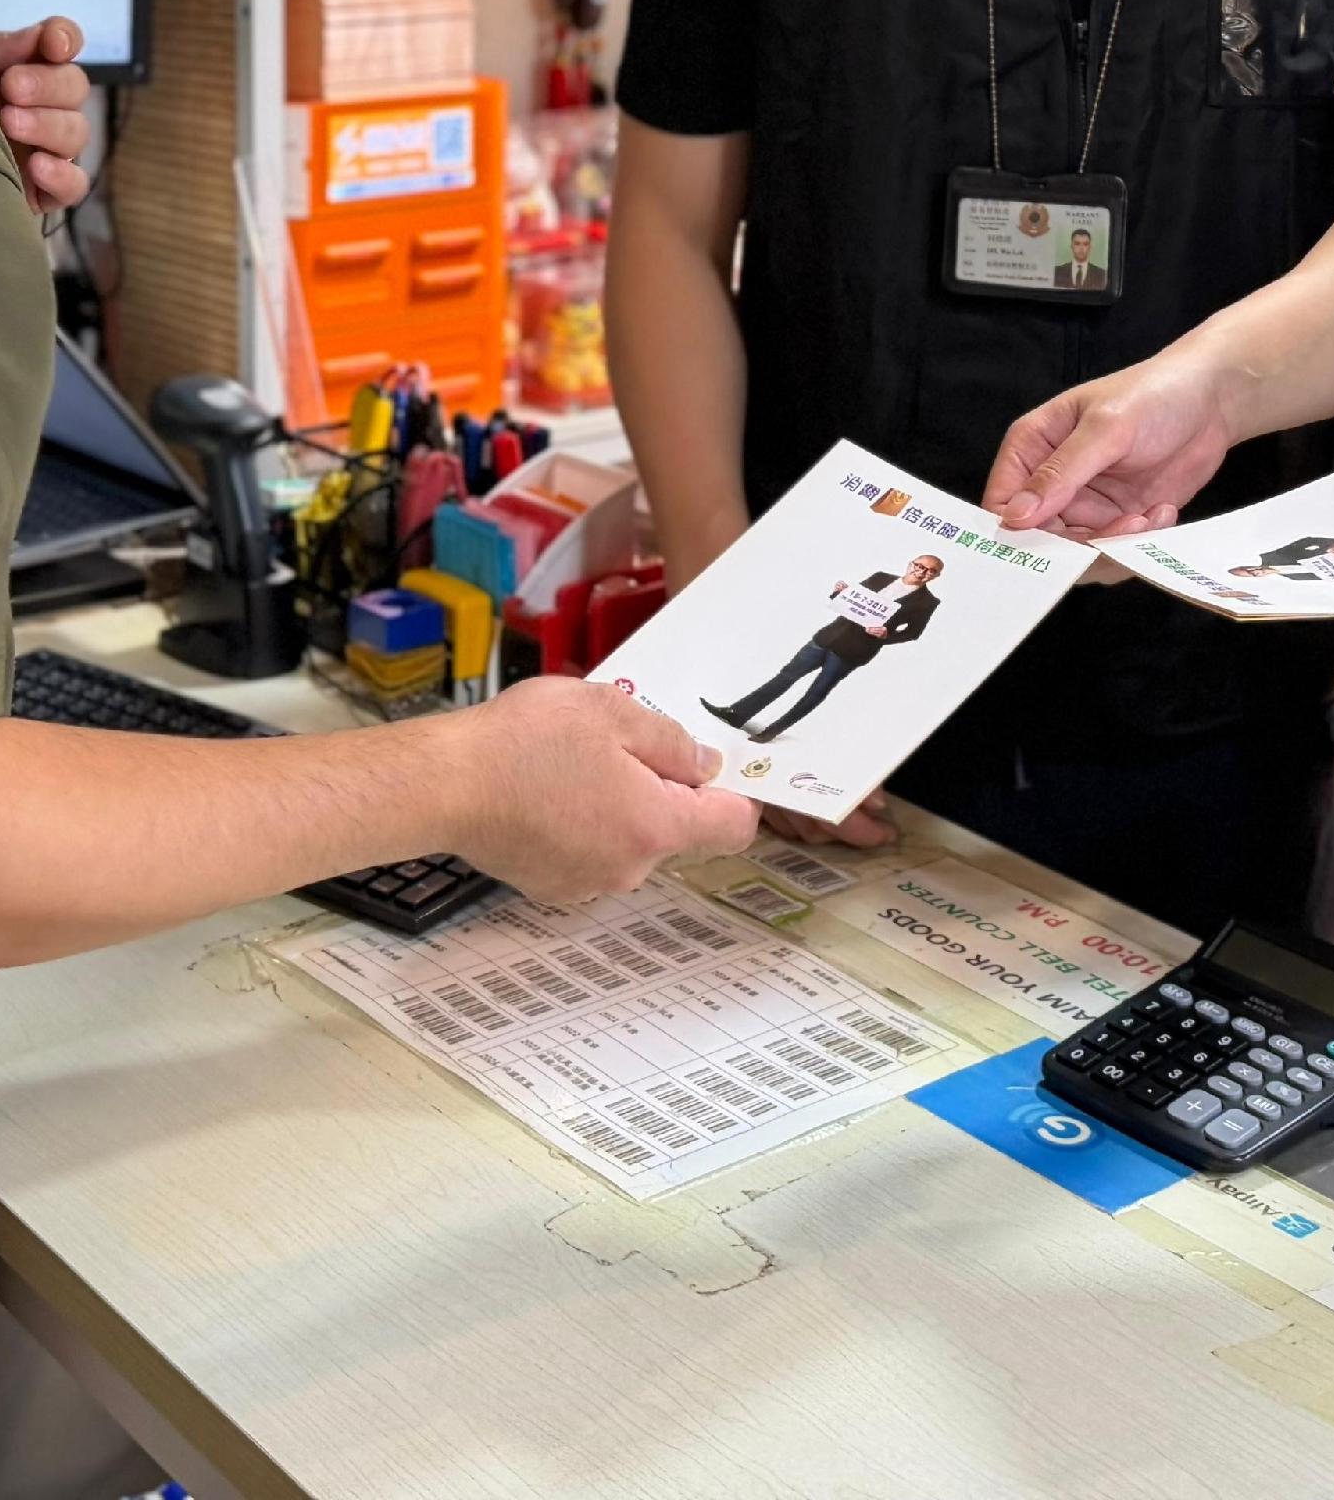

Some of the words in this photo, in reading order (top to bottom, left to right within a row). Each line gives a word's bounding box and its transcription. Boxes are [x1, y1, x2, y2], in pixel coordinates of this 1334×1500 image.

[877, 907, 967, 954] GOODS
[897, 880, 1016, 942] COUNTER
[966, 953, 1038, 995] YOUR
[1019, 941, 1081, 974] BELL
[1082, 934, 1165, 976] 10:00
[1145, 1001, 1162, 1011] 7
[1181, 1018, 1196, 1029] 8
[1218, 1036, 1233, 1047] 9
[1070, 1048, 1084, 1060] 0
[1102, 1065, 1124, 1080] 00
[1131, 1051, 1145, 1061] 2
[1168, 1069, 1183, 1080] 3
[1156, 1033, 1172, 1044] 5
[1193, 1052, 1208, 1063] 6
[1206, 1177, 1283, 1218] Alipay
